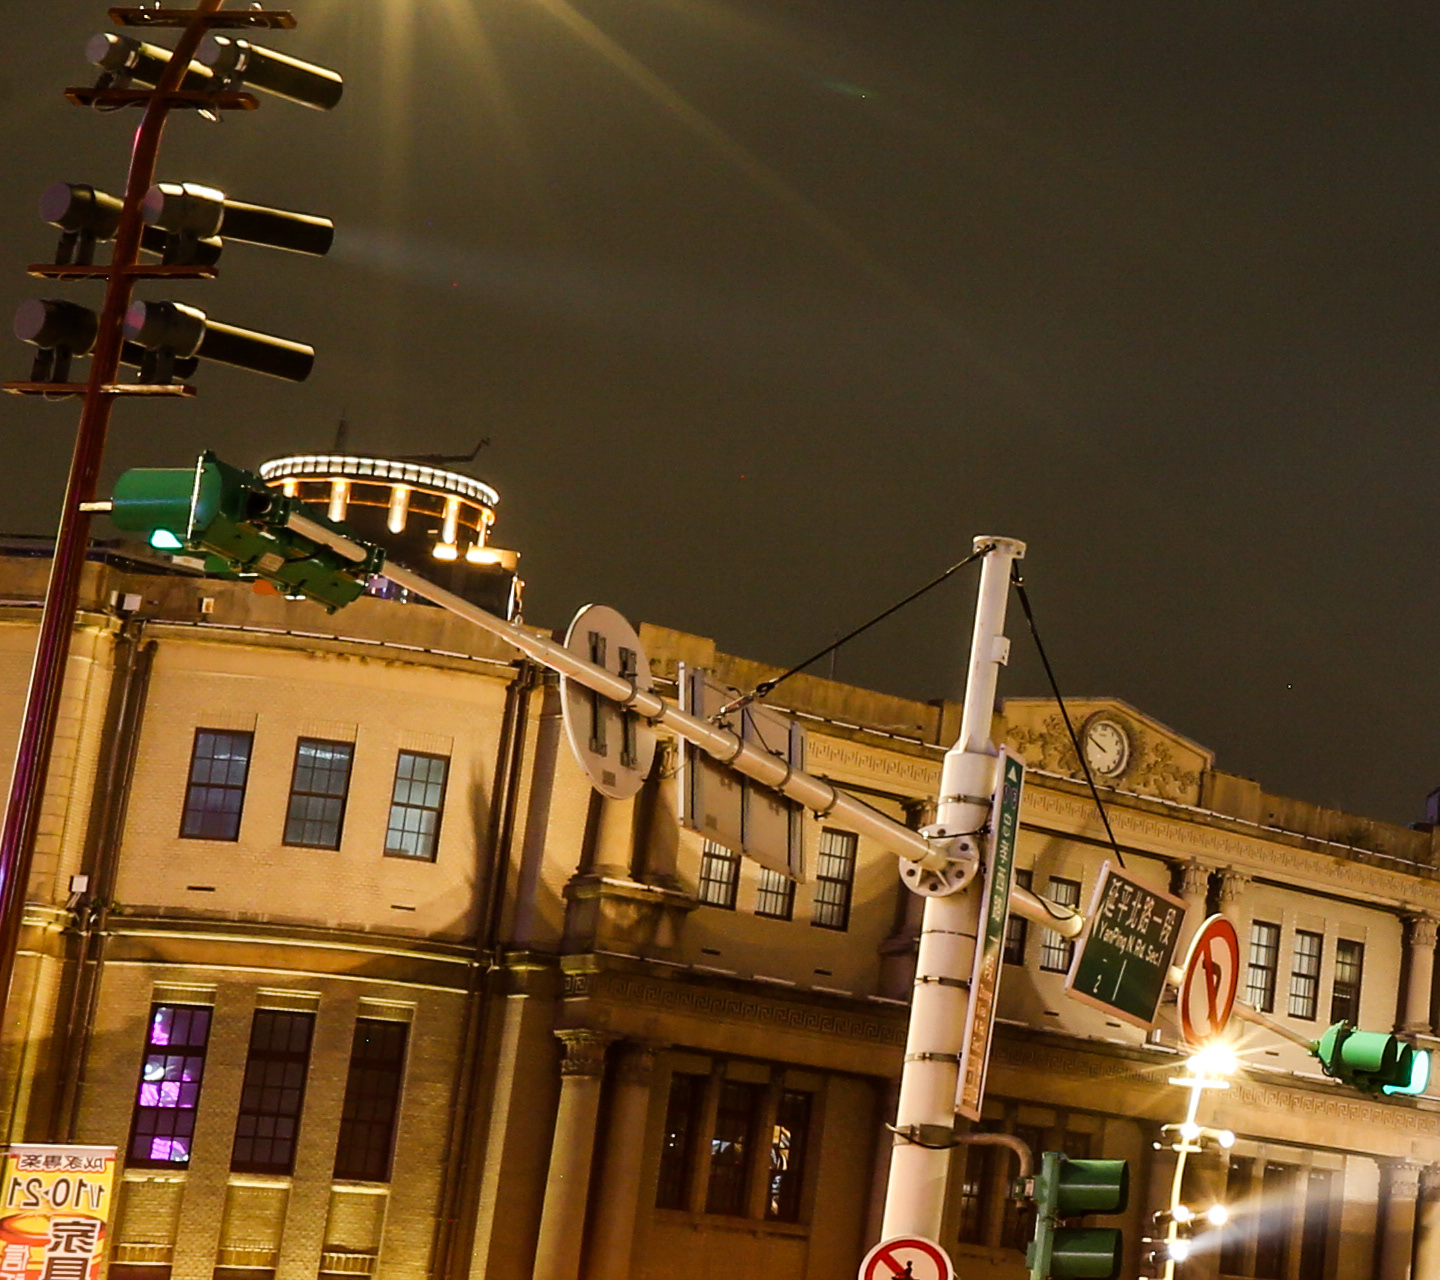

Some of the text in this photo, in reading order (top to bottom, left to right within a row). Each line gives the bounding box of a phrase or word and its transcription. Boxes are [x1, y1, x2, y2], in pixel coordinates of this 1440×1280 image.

[1103, 878, 1176, 945] 延平北路一段
